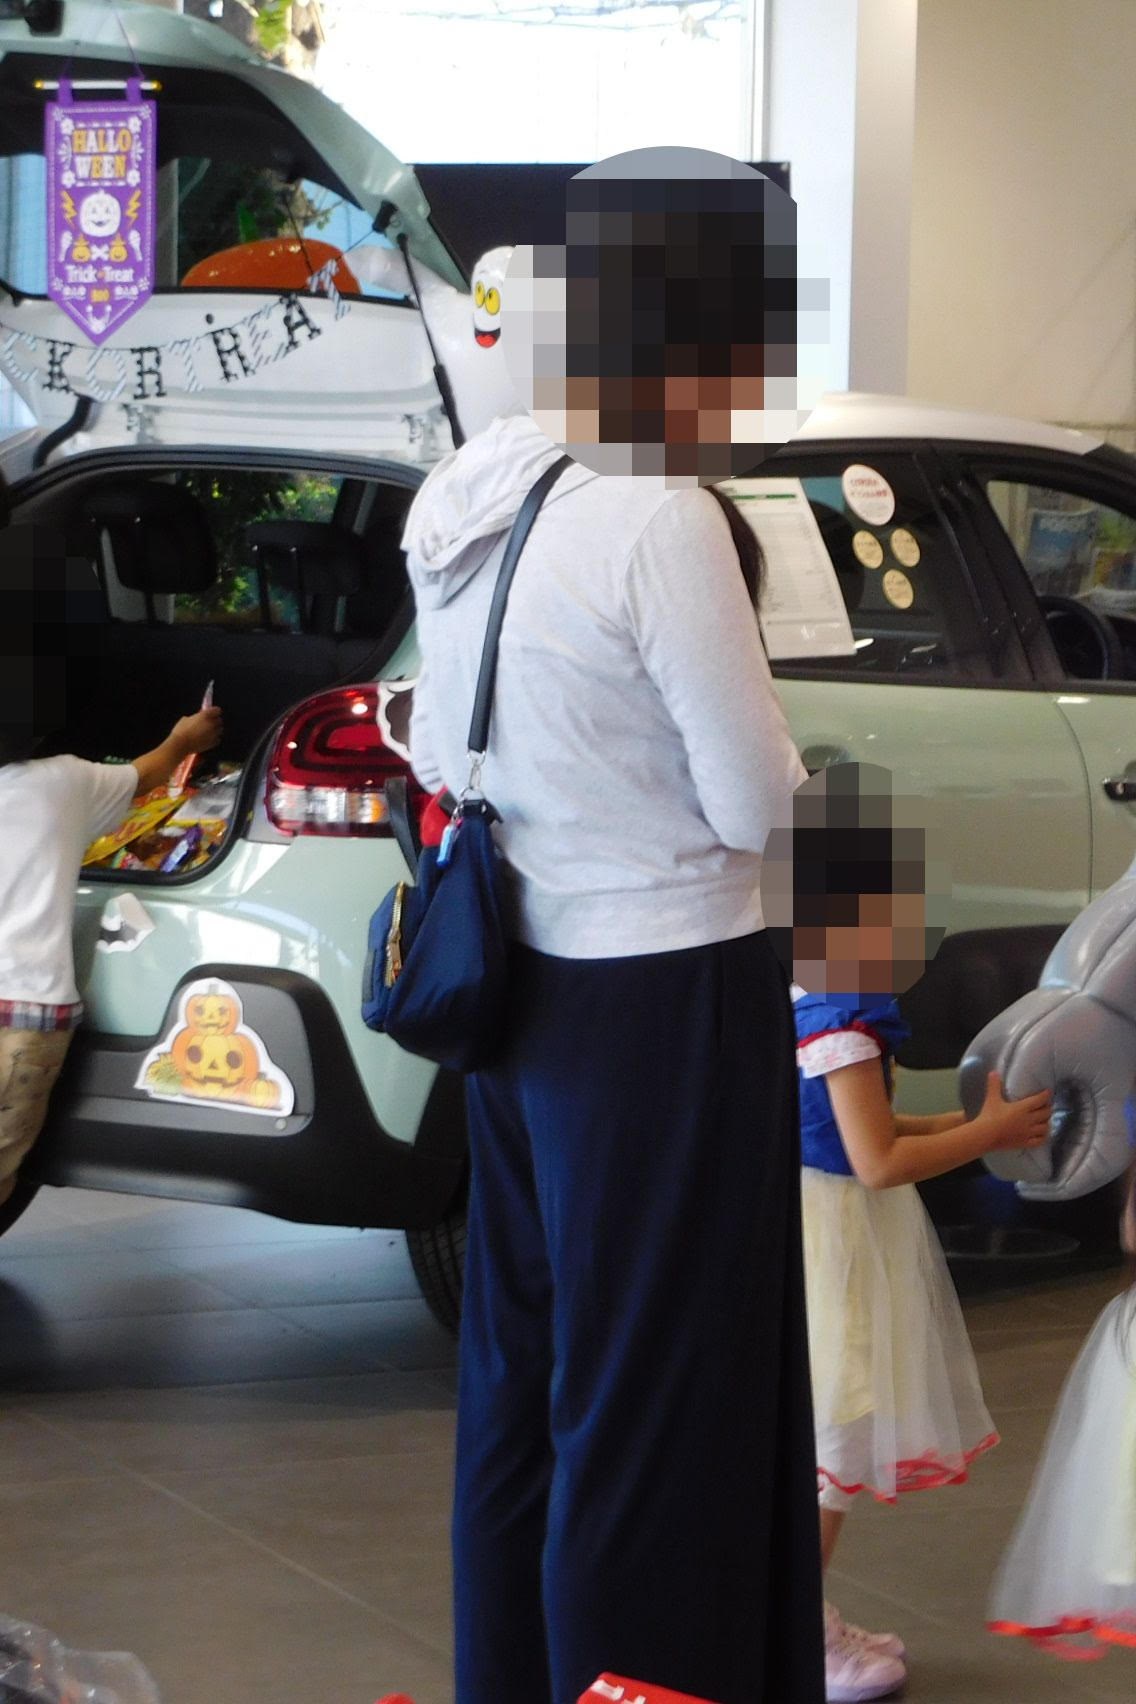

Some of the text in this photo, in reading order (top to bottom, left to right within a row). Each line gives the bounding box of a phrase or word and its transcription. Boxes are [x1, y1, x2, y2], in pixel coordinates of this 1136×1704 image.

[73, 129, 132, 153] HALLO
[75, 155, 126, 179] WEEN
[66, 265, 97, 282] Trick
[104, 266, 134, 282] Treat
[168, 259, 352, 392] TREAT
